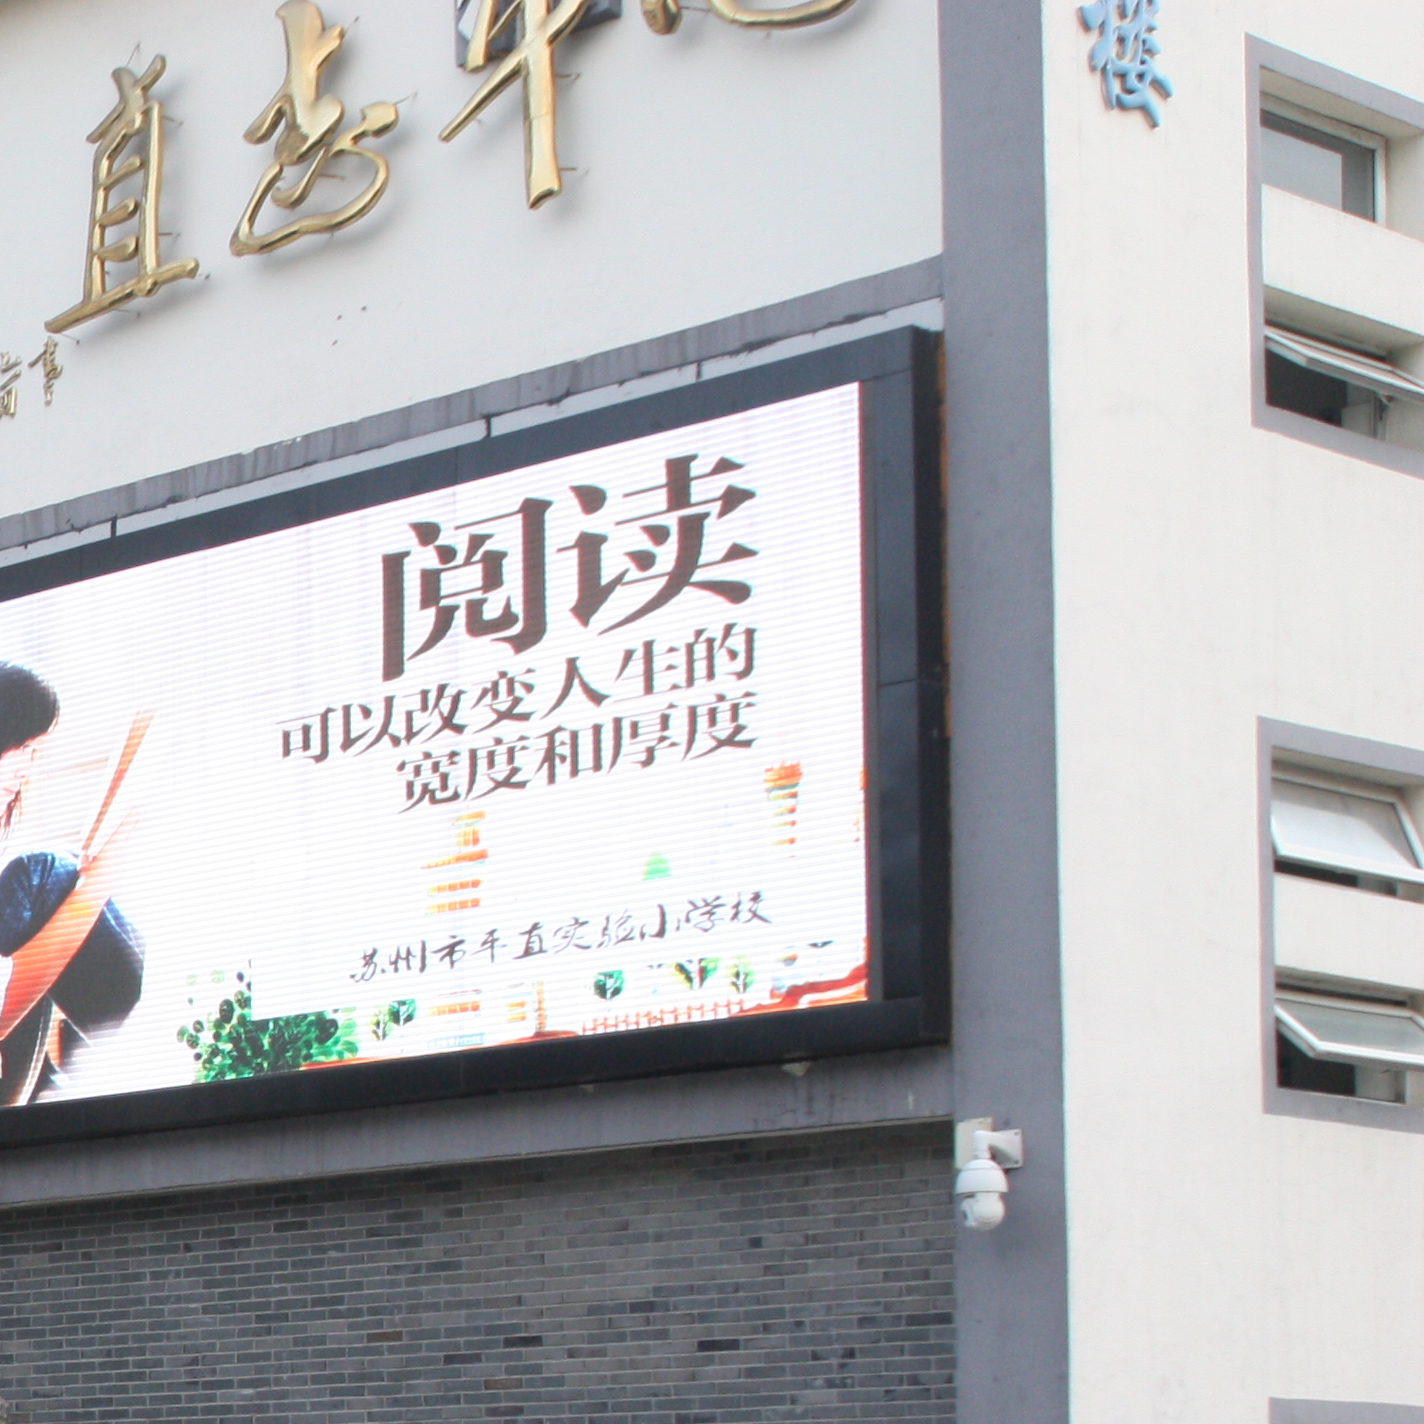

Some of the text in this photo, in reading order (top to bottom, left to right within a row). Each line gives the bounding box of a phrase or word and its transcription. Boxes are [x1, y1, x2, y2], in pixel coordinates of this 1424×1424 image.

[381, 452, 760, 682] 阅读
[276, 622, 758, 764] 可以改变人生的
[396, 691, 758, 815] 宽度和厚度
[349, 891, 772, 983] 苏州市平直实验小学校
